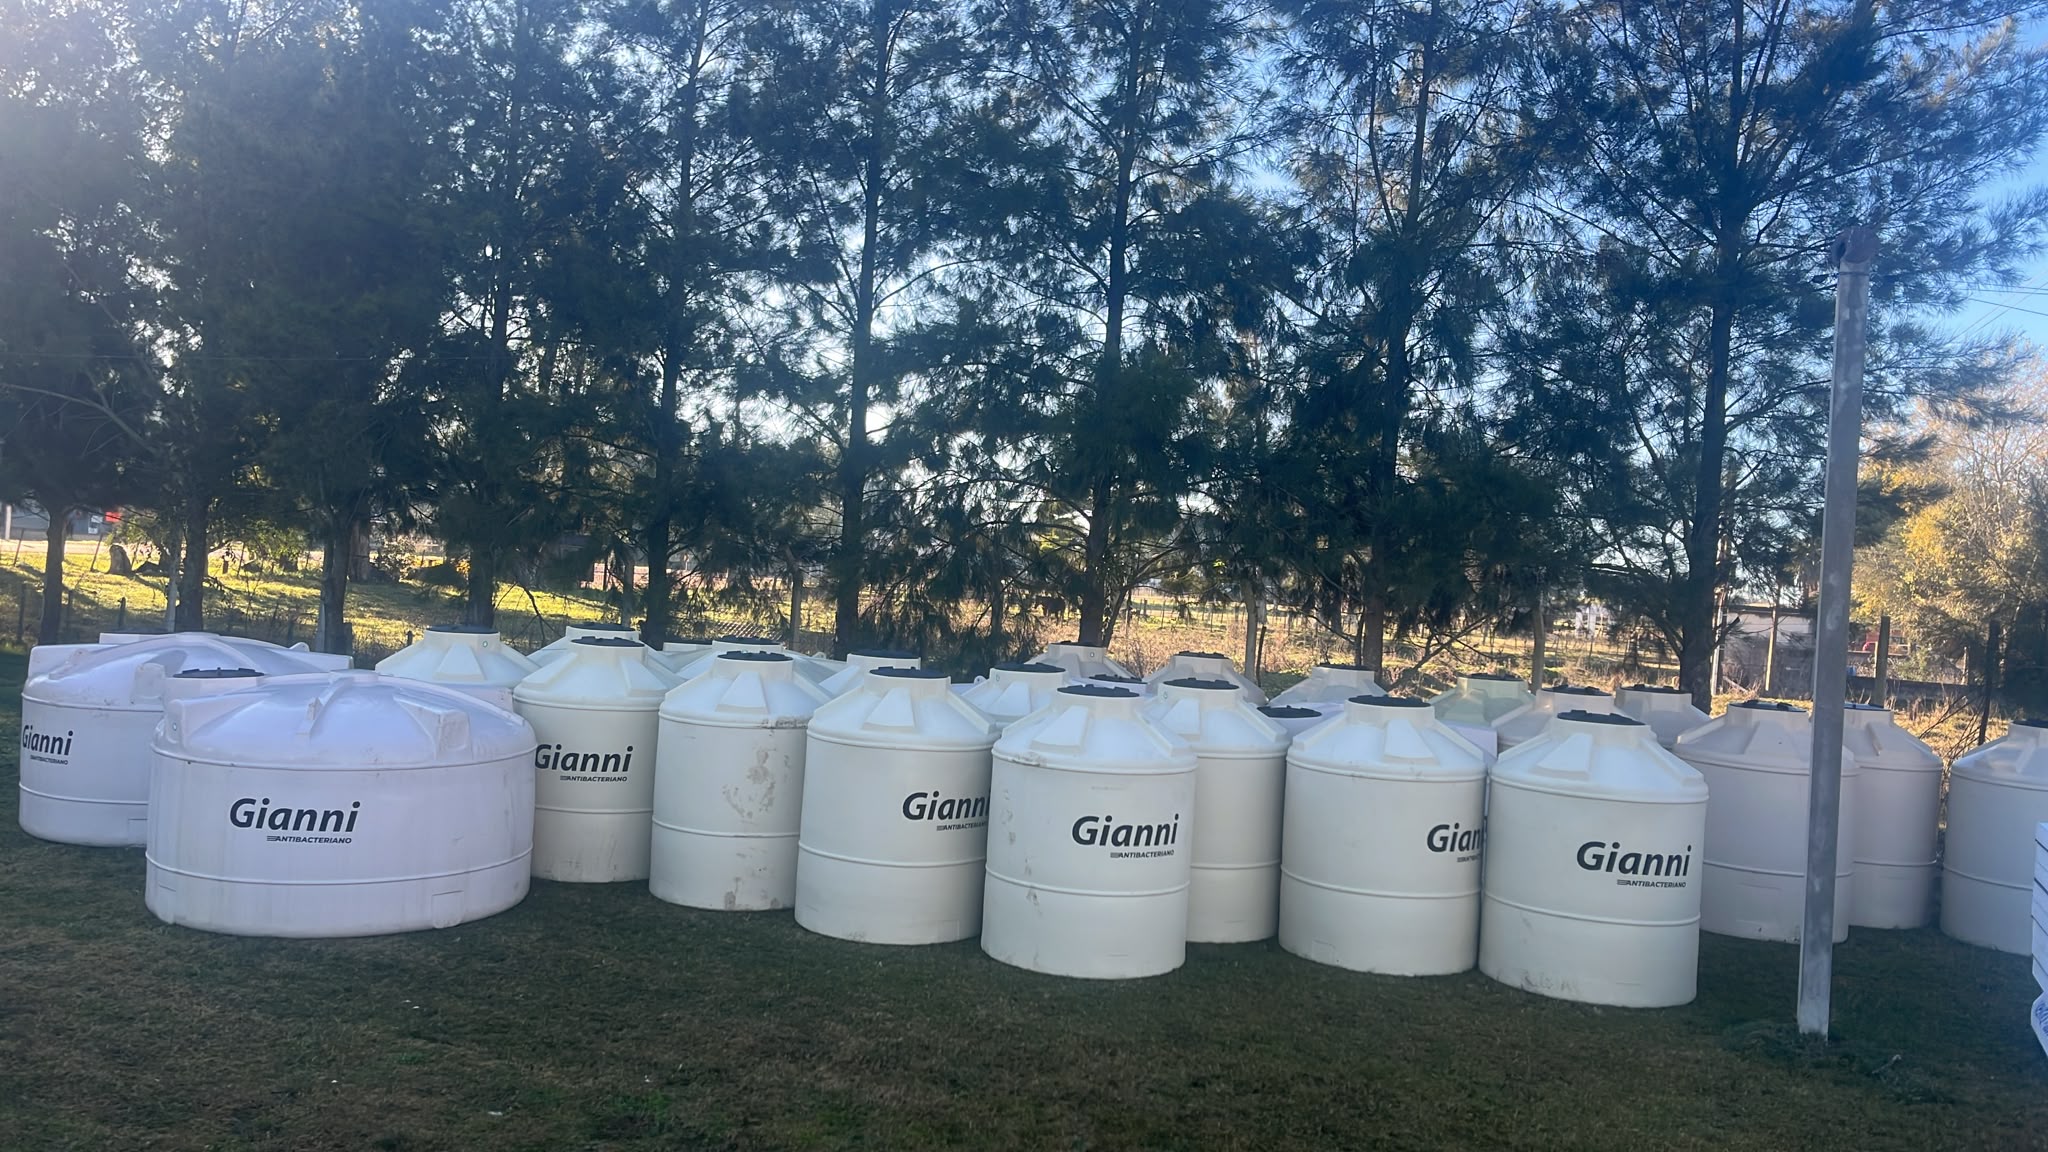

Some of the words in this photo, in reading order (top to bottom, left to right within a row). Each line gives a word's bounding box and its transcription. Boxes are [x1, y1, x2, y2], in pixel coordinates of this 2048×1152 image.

[23, 725, 73, 756] Gianni
[535, 744, 633, 773] Gianni
[229, 798, 361, 832] Gianni
[1072, 813, 1179, 847] Gianni
[274, 836, 352, 844] ANTIBACTERIANO
[1427, 822, 1481, 853] Gian
[1118, 849, 1174, 859] ANTIBACTERIANO
[1576, 841, 1692, 876] Gianni
[1625, 880, 1687, 888] ANTIBACTERIANO
